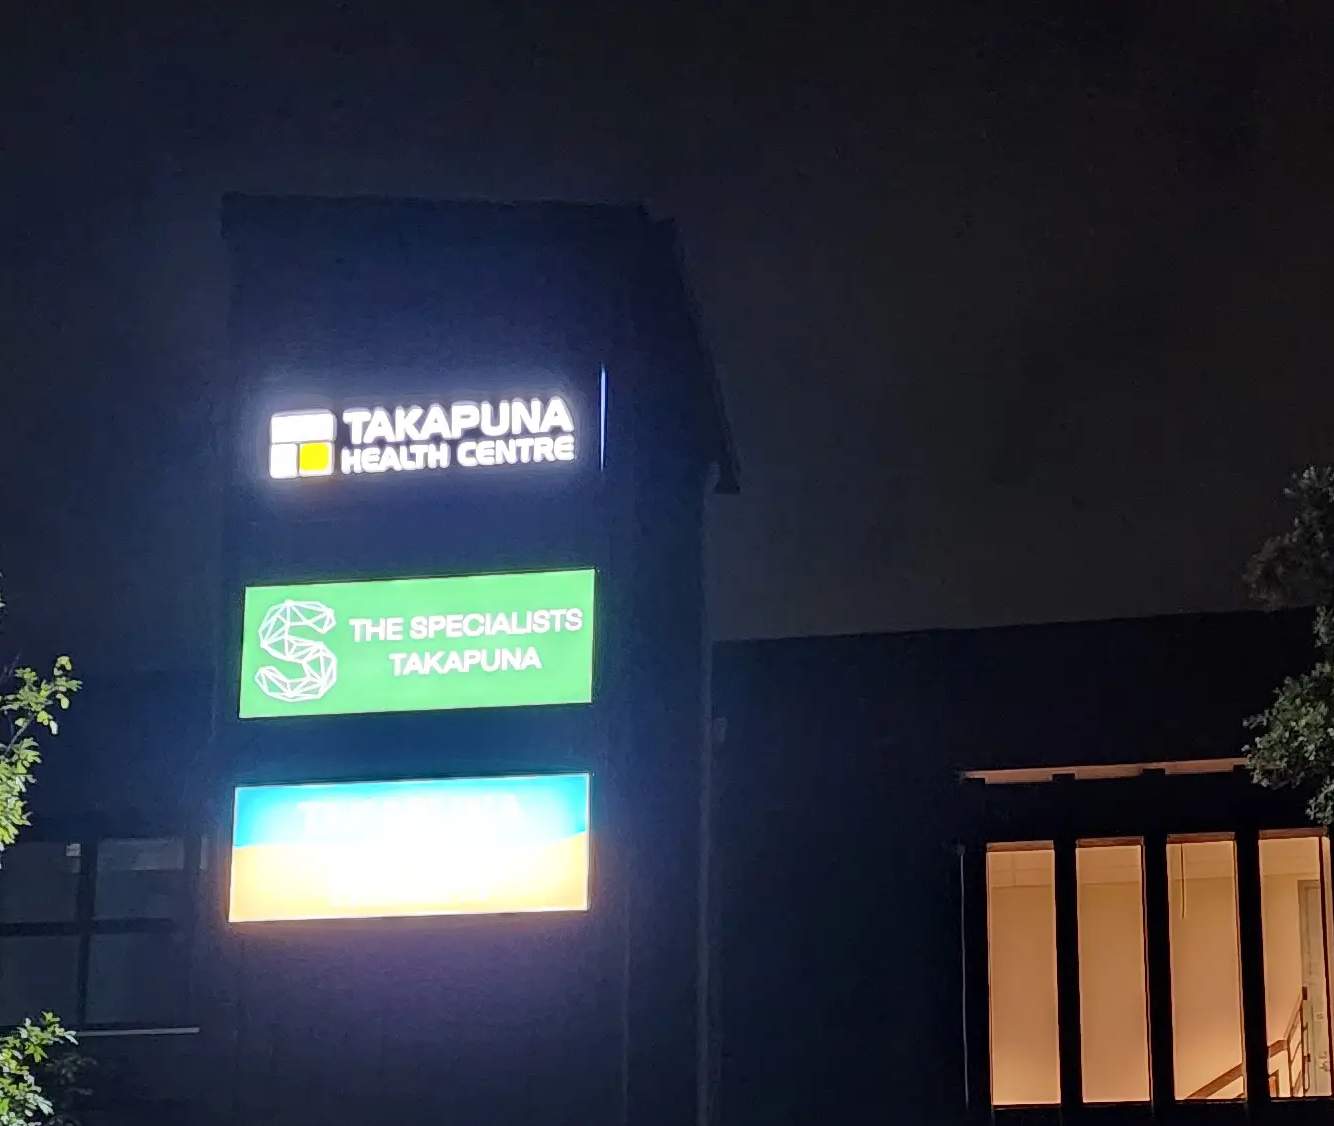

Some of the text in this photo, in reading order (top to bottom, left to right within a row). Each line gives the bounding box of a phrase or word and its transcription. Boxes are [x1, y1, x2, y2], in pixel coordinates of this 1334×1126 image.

[343, 396, 573, 445] TAKAPUNA
[341, 434, 576, 475] HEALTH CENTRE
[349, 608, 584, 643] THE SPECIALISTS
[388, 648, 543, 678] TAKAPUNA
